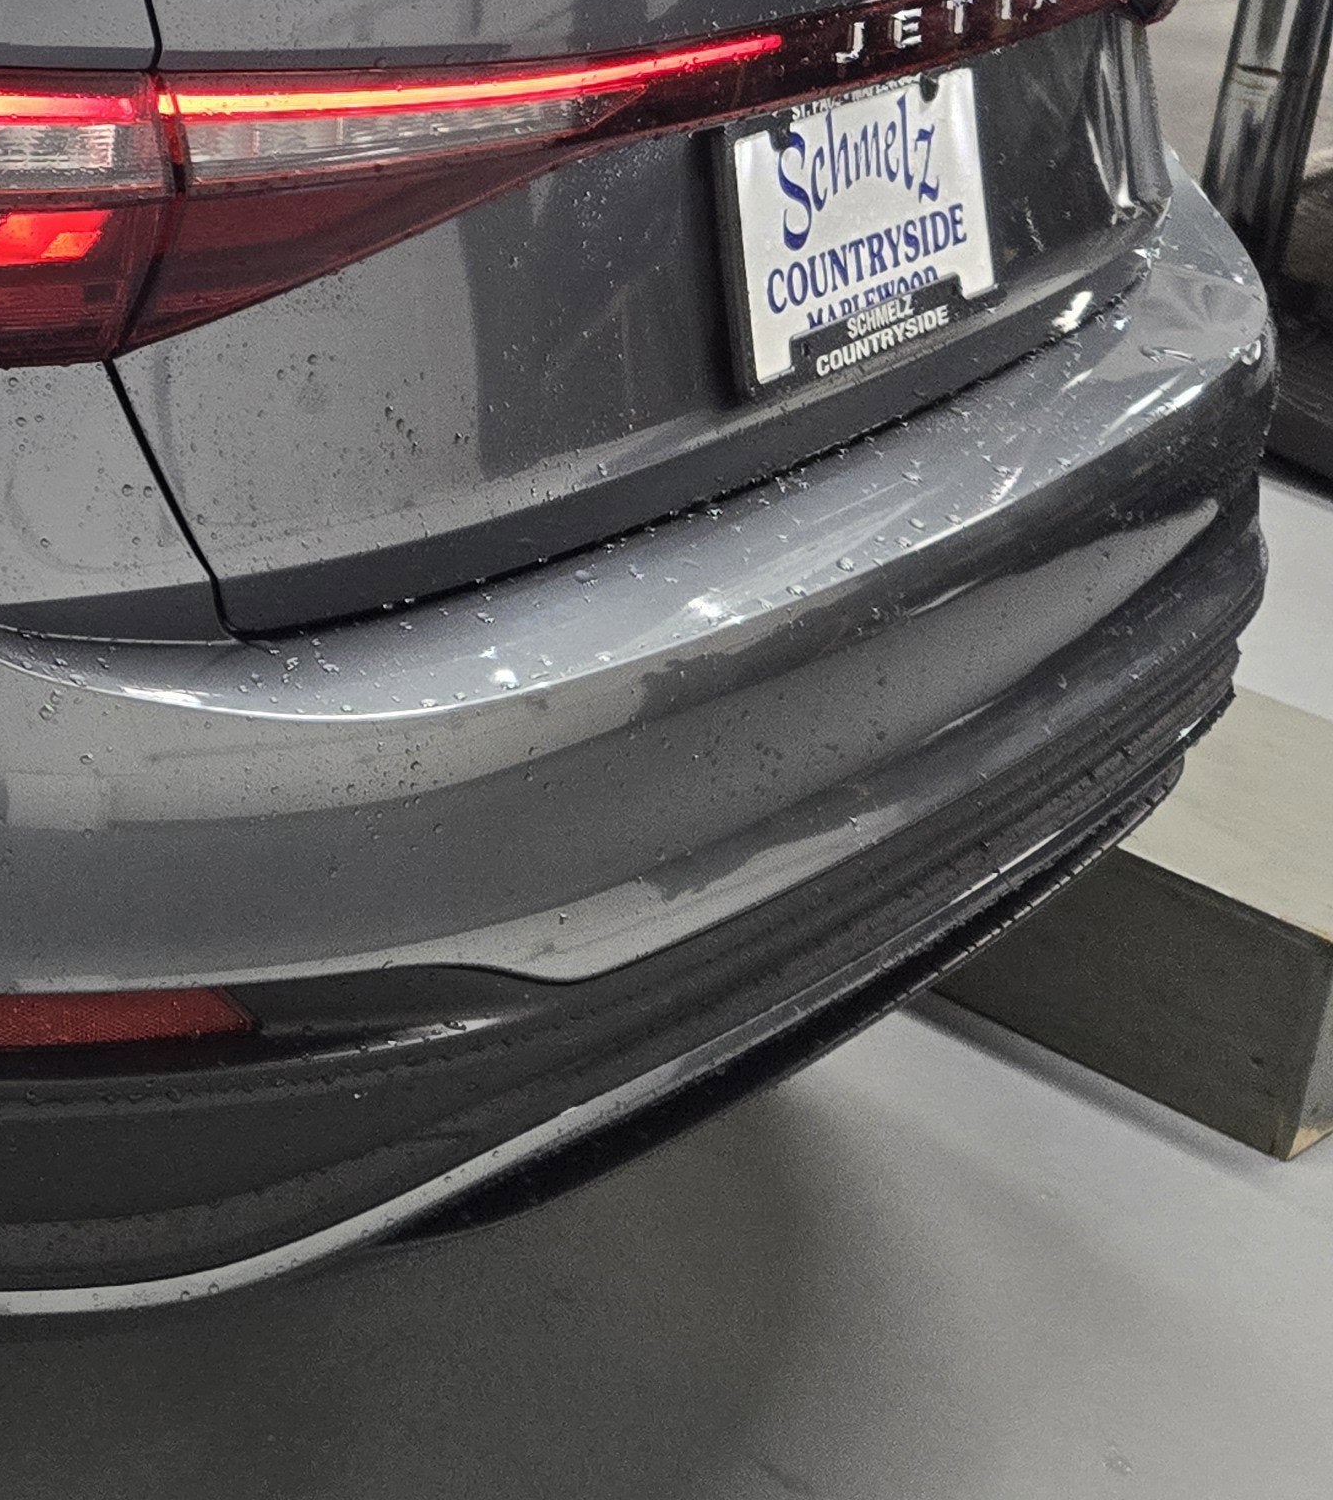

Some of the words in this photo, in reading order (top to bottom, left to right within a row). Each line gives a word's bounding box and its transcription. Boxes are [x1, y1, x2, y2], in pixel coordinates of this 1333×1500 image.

[778, 92, 940, 252] Schmelz
[767, 202, 967, 315] COUNTRYSIDE
[816, 304, 950, 378] COUNTRYSIDE
[846, 295, 915, 340] SCHMELZ
